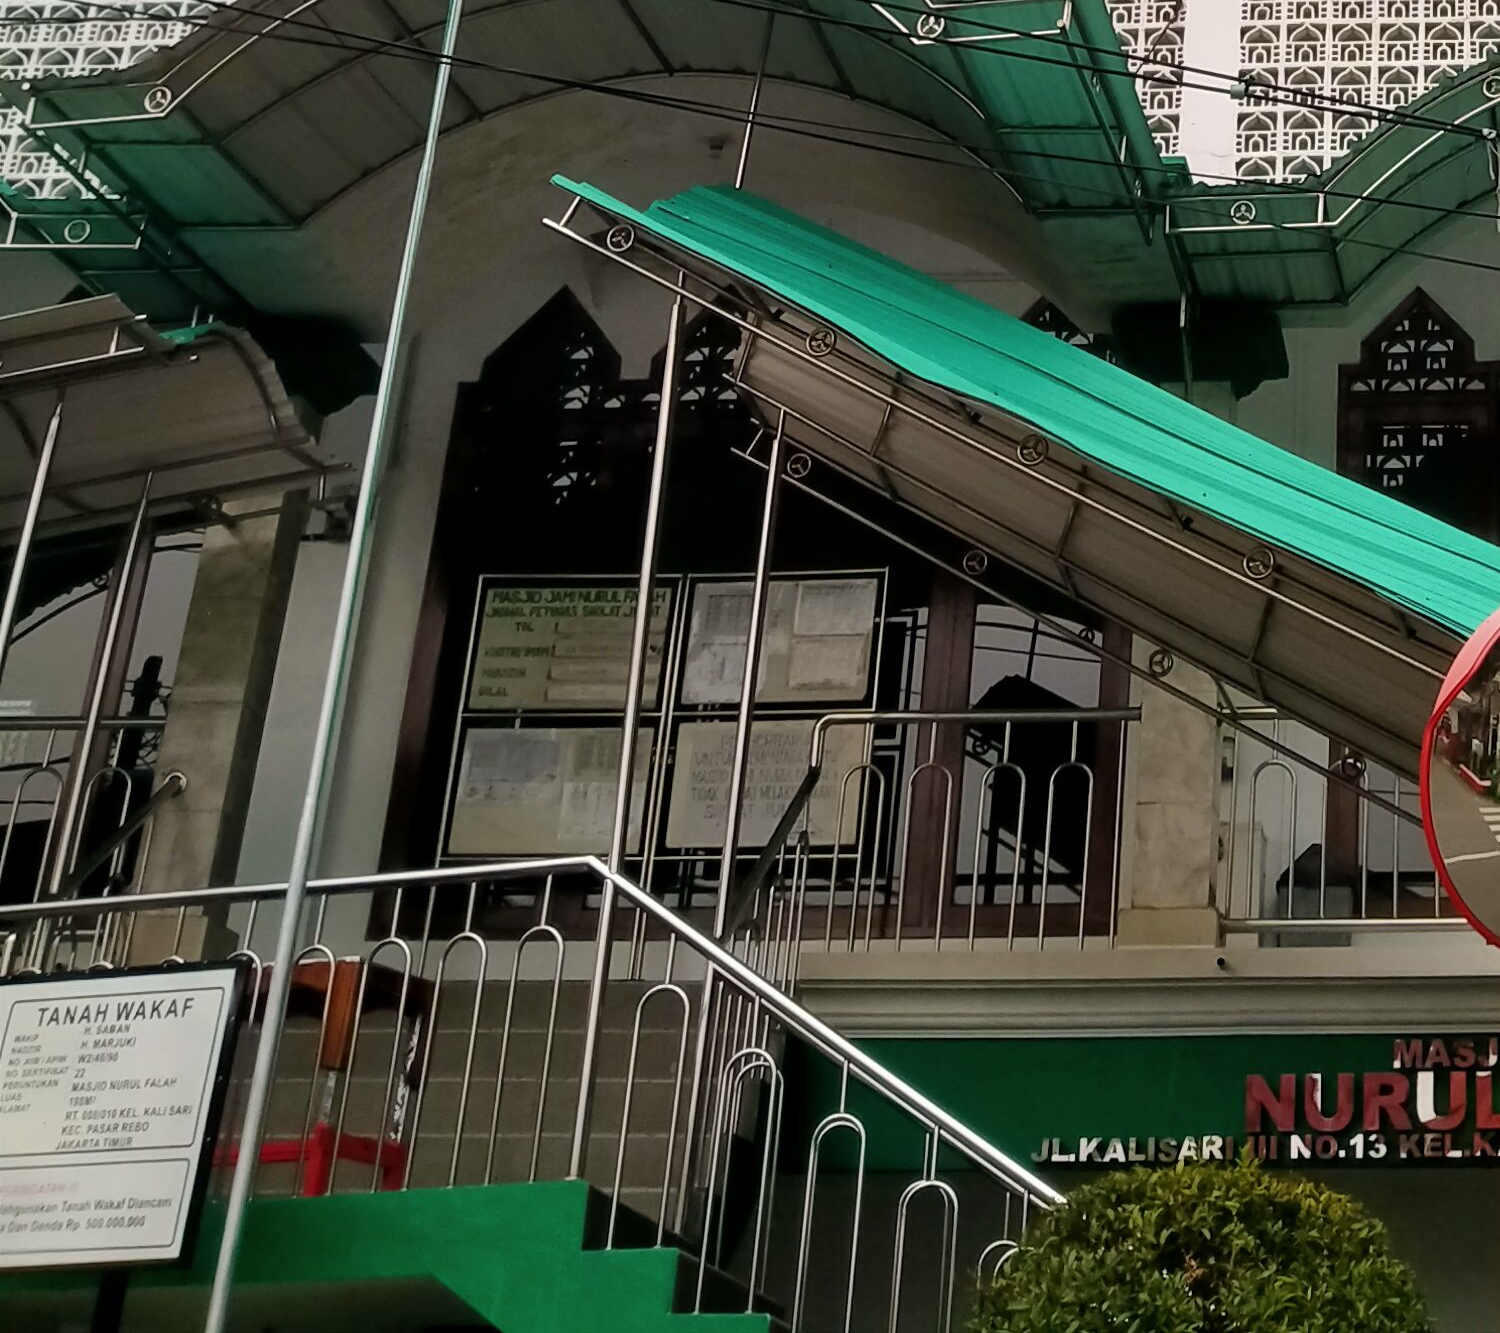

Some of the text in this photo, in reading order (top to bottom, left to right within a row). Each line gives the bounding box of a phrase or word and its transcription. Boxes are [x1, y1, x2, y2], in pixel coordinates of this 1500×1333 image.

[492, 590, 542, 604] MASJID
[578, 590, 622, 604] NURUL
[37, 997, 195, 1027] TANAH WAKAF
[92, 1037, 137, 1049] MARJUKI
[71, 1081, 107, 1092] MASJID
[109, 1079, 141, 1091] NURUL
[143, 1077, 178, 1088] FALAH
[86, 1123, 119, 1134] PASAR
[121, 1121, 150, 1133] REBO
[55, 1136, 134, 1151] JAKARTA TIMUR
[1290, 1134, 1388, 1160] NO.13
[94, 1198, 125, 1211] Wakaf
